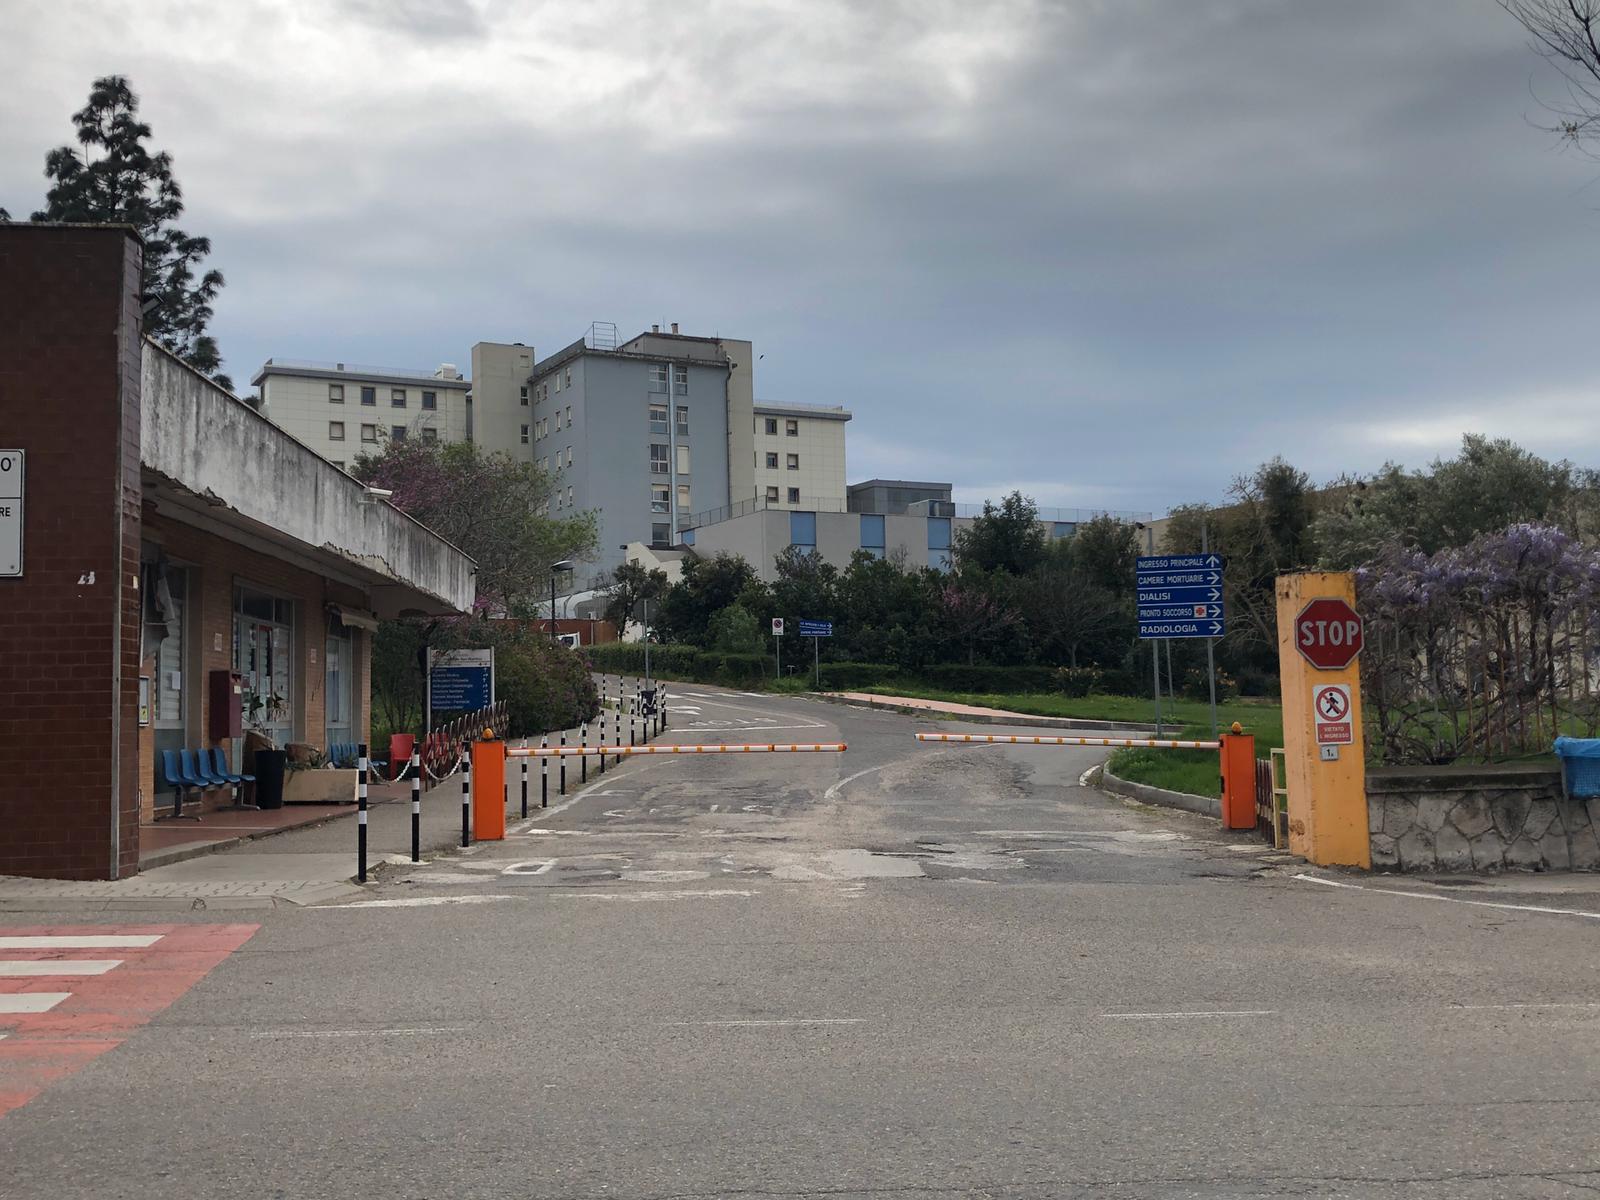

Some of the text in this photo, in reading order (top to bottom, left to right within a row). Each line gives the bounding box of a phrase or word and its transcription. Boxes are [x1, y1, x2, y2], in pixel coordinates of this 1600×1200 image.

[1138, 558, 1204, 568] INGRESSO PRINCIPALE
[1138, 575, 1204, 584] CAMERE MORTUARIE
[1140, 593, 1171, 601] DIALISI
[1141, 625, 1197, 633] RADIOLOGIA
[1301, 621, 1359, 646] STOP
